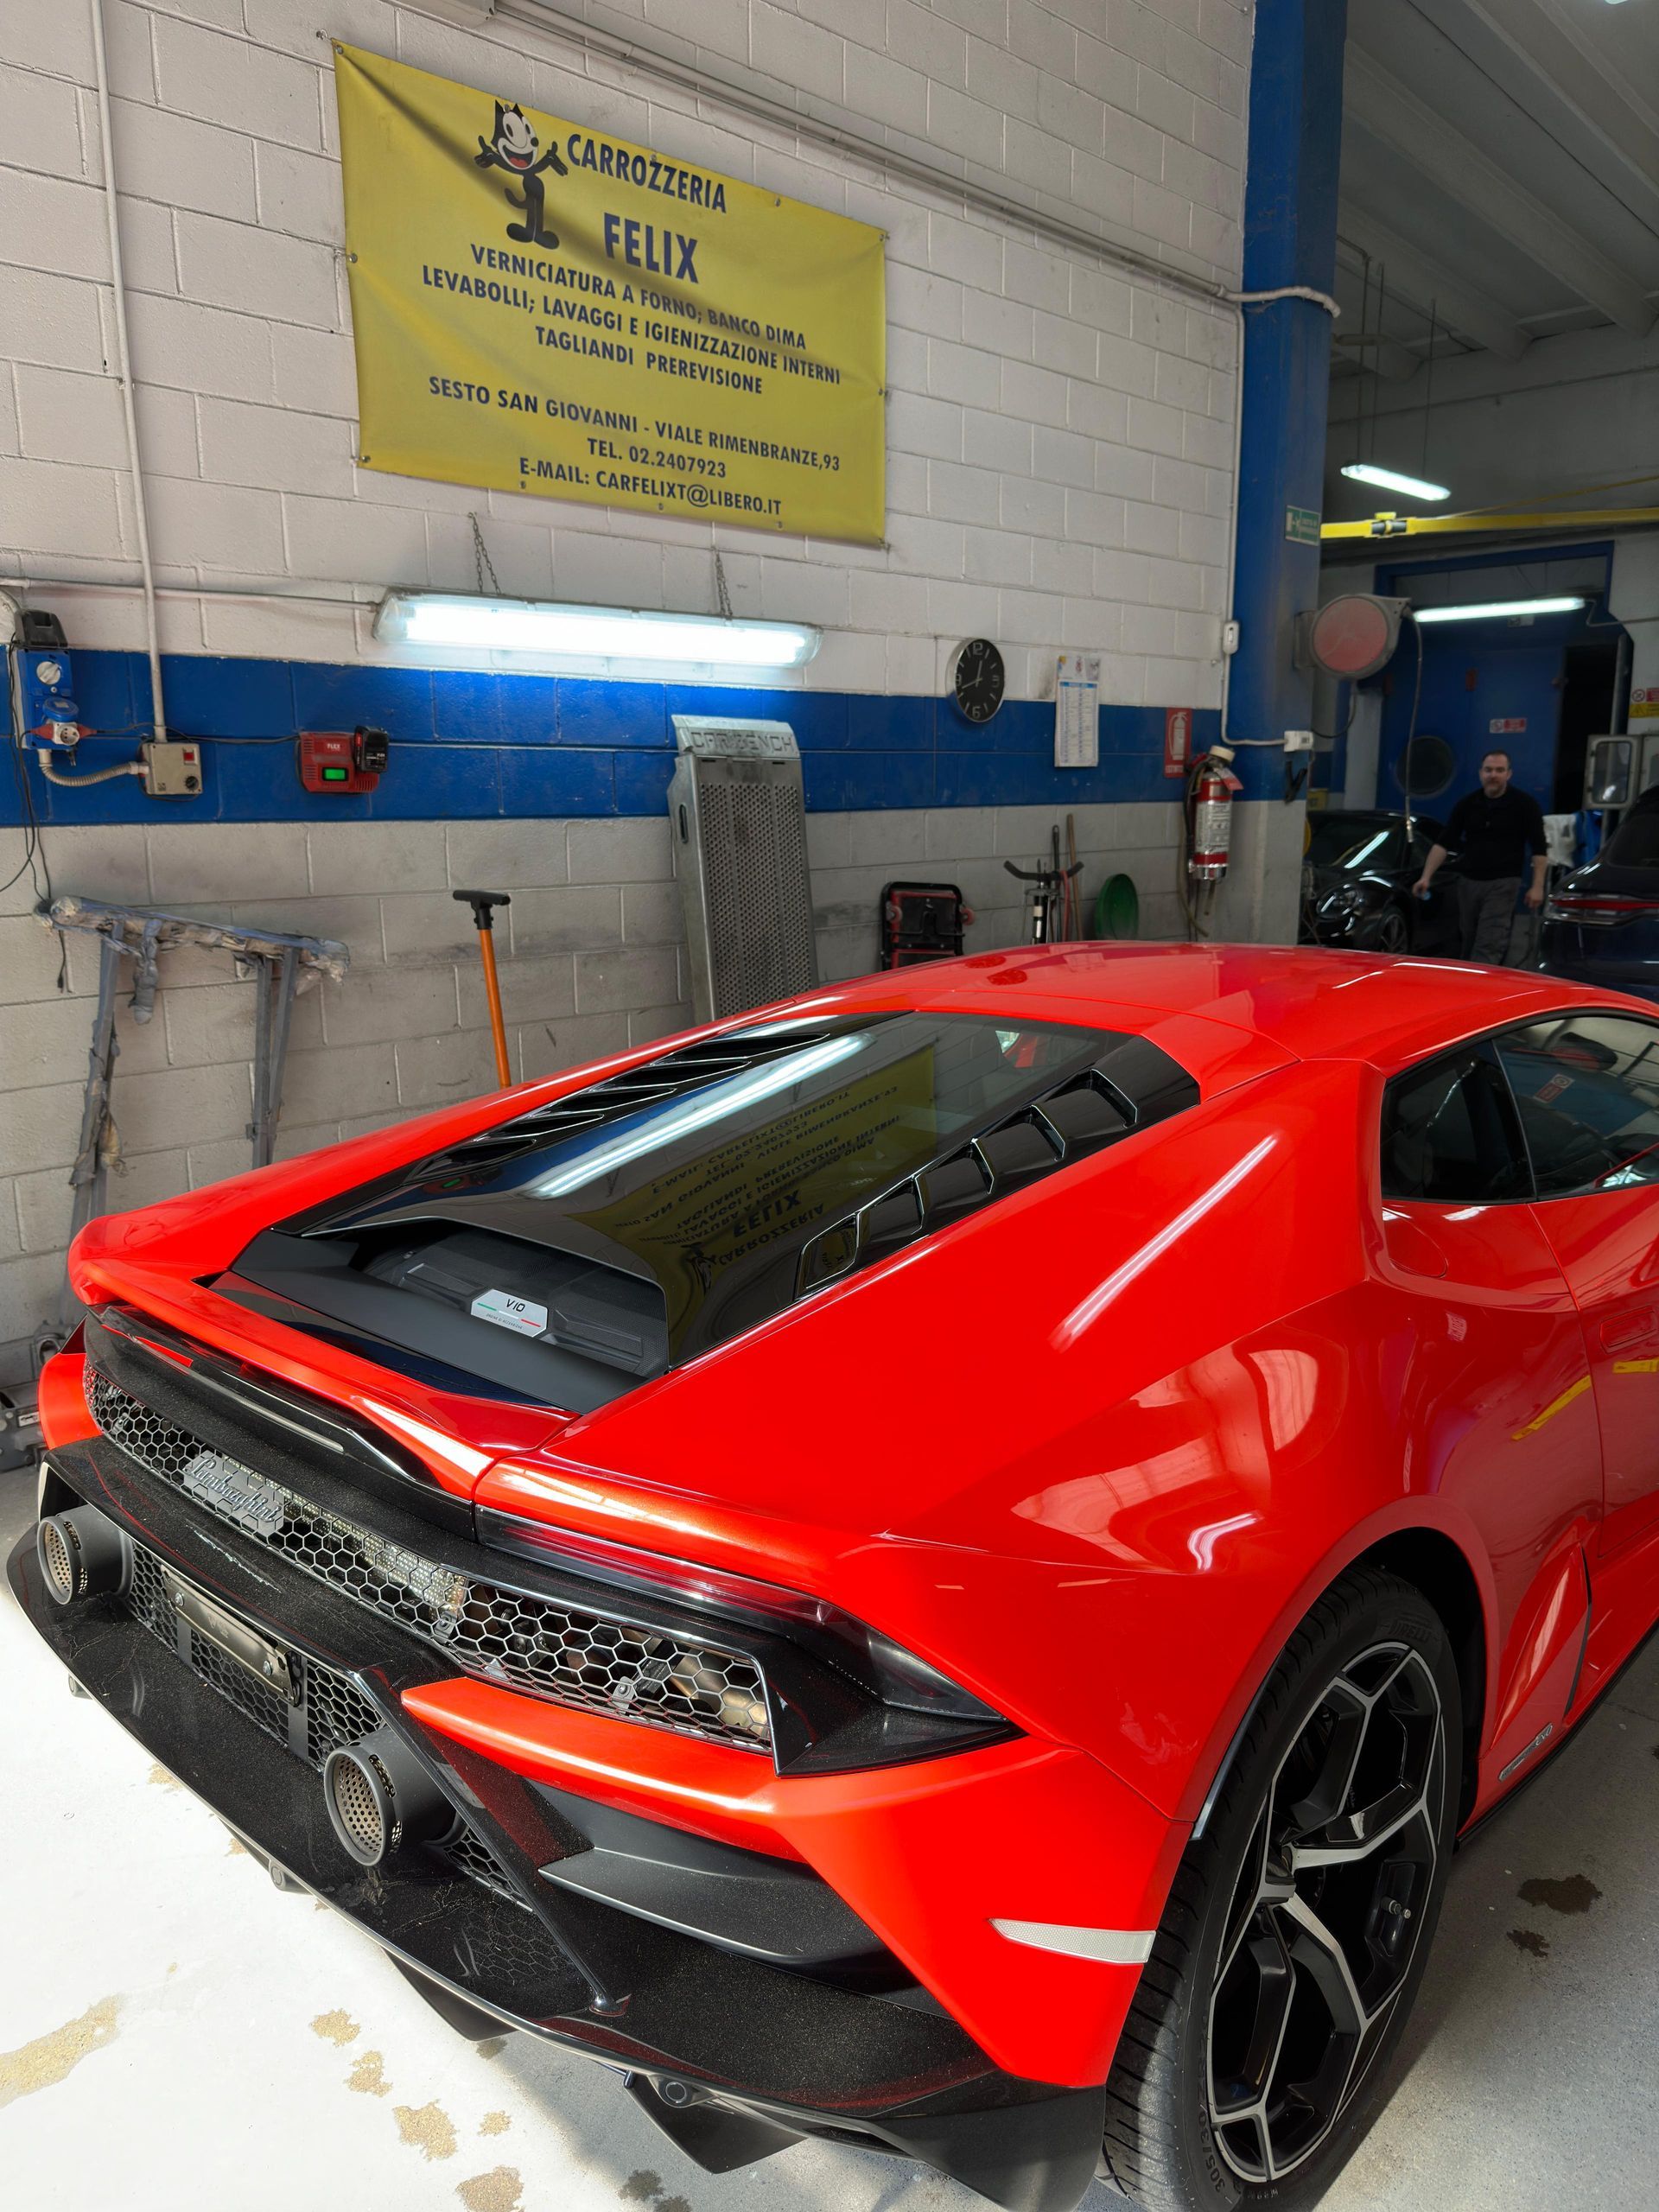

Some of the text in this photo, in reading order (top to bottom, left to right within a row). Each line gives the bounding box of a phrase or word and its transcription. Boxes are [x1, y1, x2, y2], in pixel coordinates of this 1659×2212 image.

[567, 133, 727, 213] CARROZZERIA
[603, 212, 699, 284] FELIX
[423, 264, 841, 385] LEVABOLLI; LAVAGGI E IGIENIZZAZIONE INTERNI
[470, 243, 806, 350] VERNICIATURA A FORNO; BANCO DIMA
[535, 325, 762, 394] TAGLIANDI PREREVISIONE
[429, 376, 490, 404] SESTO
[498, 390, 538, 413] SAN
[545, 398, 638, 433] GIOVANNI
[654, 421, 702, 446] VIALE
[709, 431, 840, 471] RIMENBRANZE,93
[587, 437, 727, 478] TEL. 02.2407923
[519, 456, 782, 516] E-MAIL: CARFELIXT@LIBERO.IT
[505, 1298, 526, 1313] V10
[182, 1458, 282, 1522] Lamborghini
